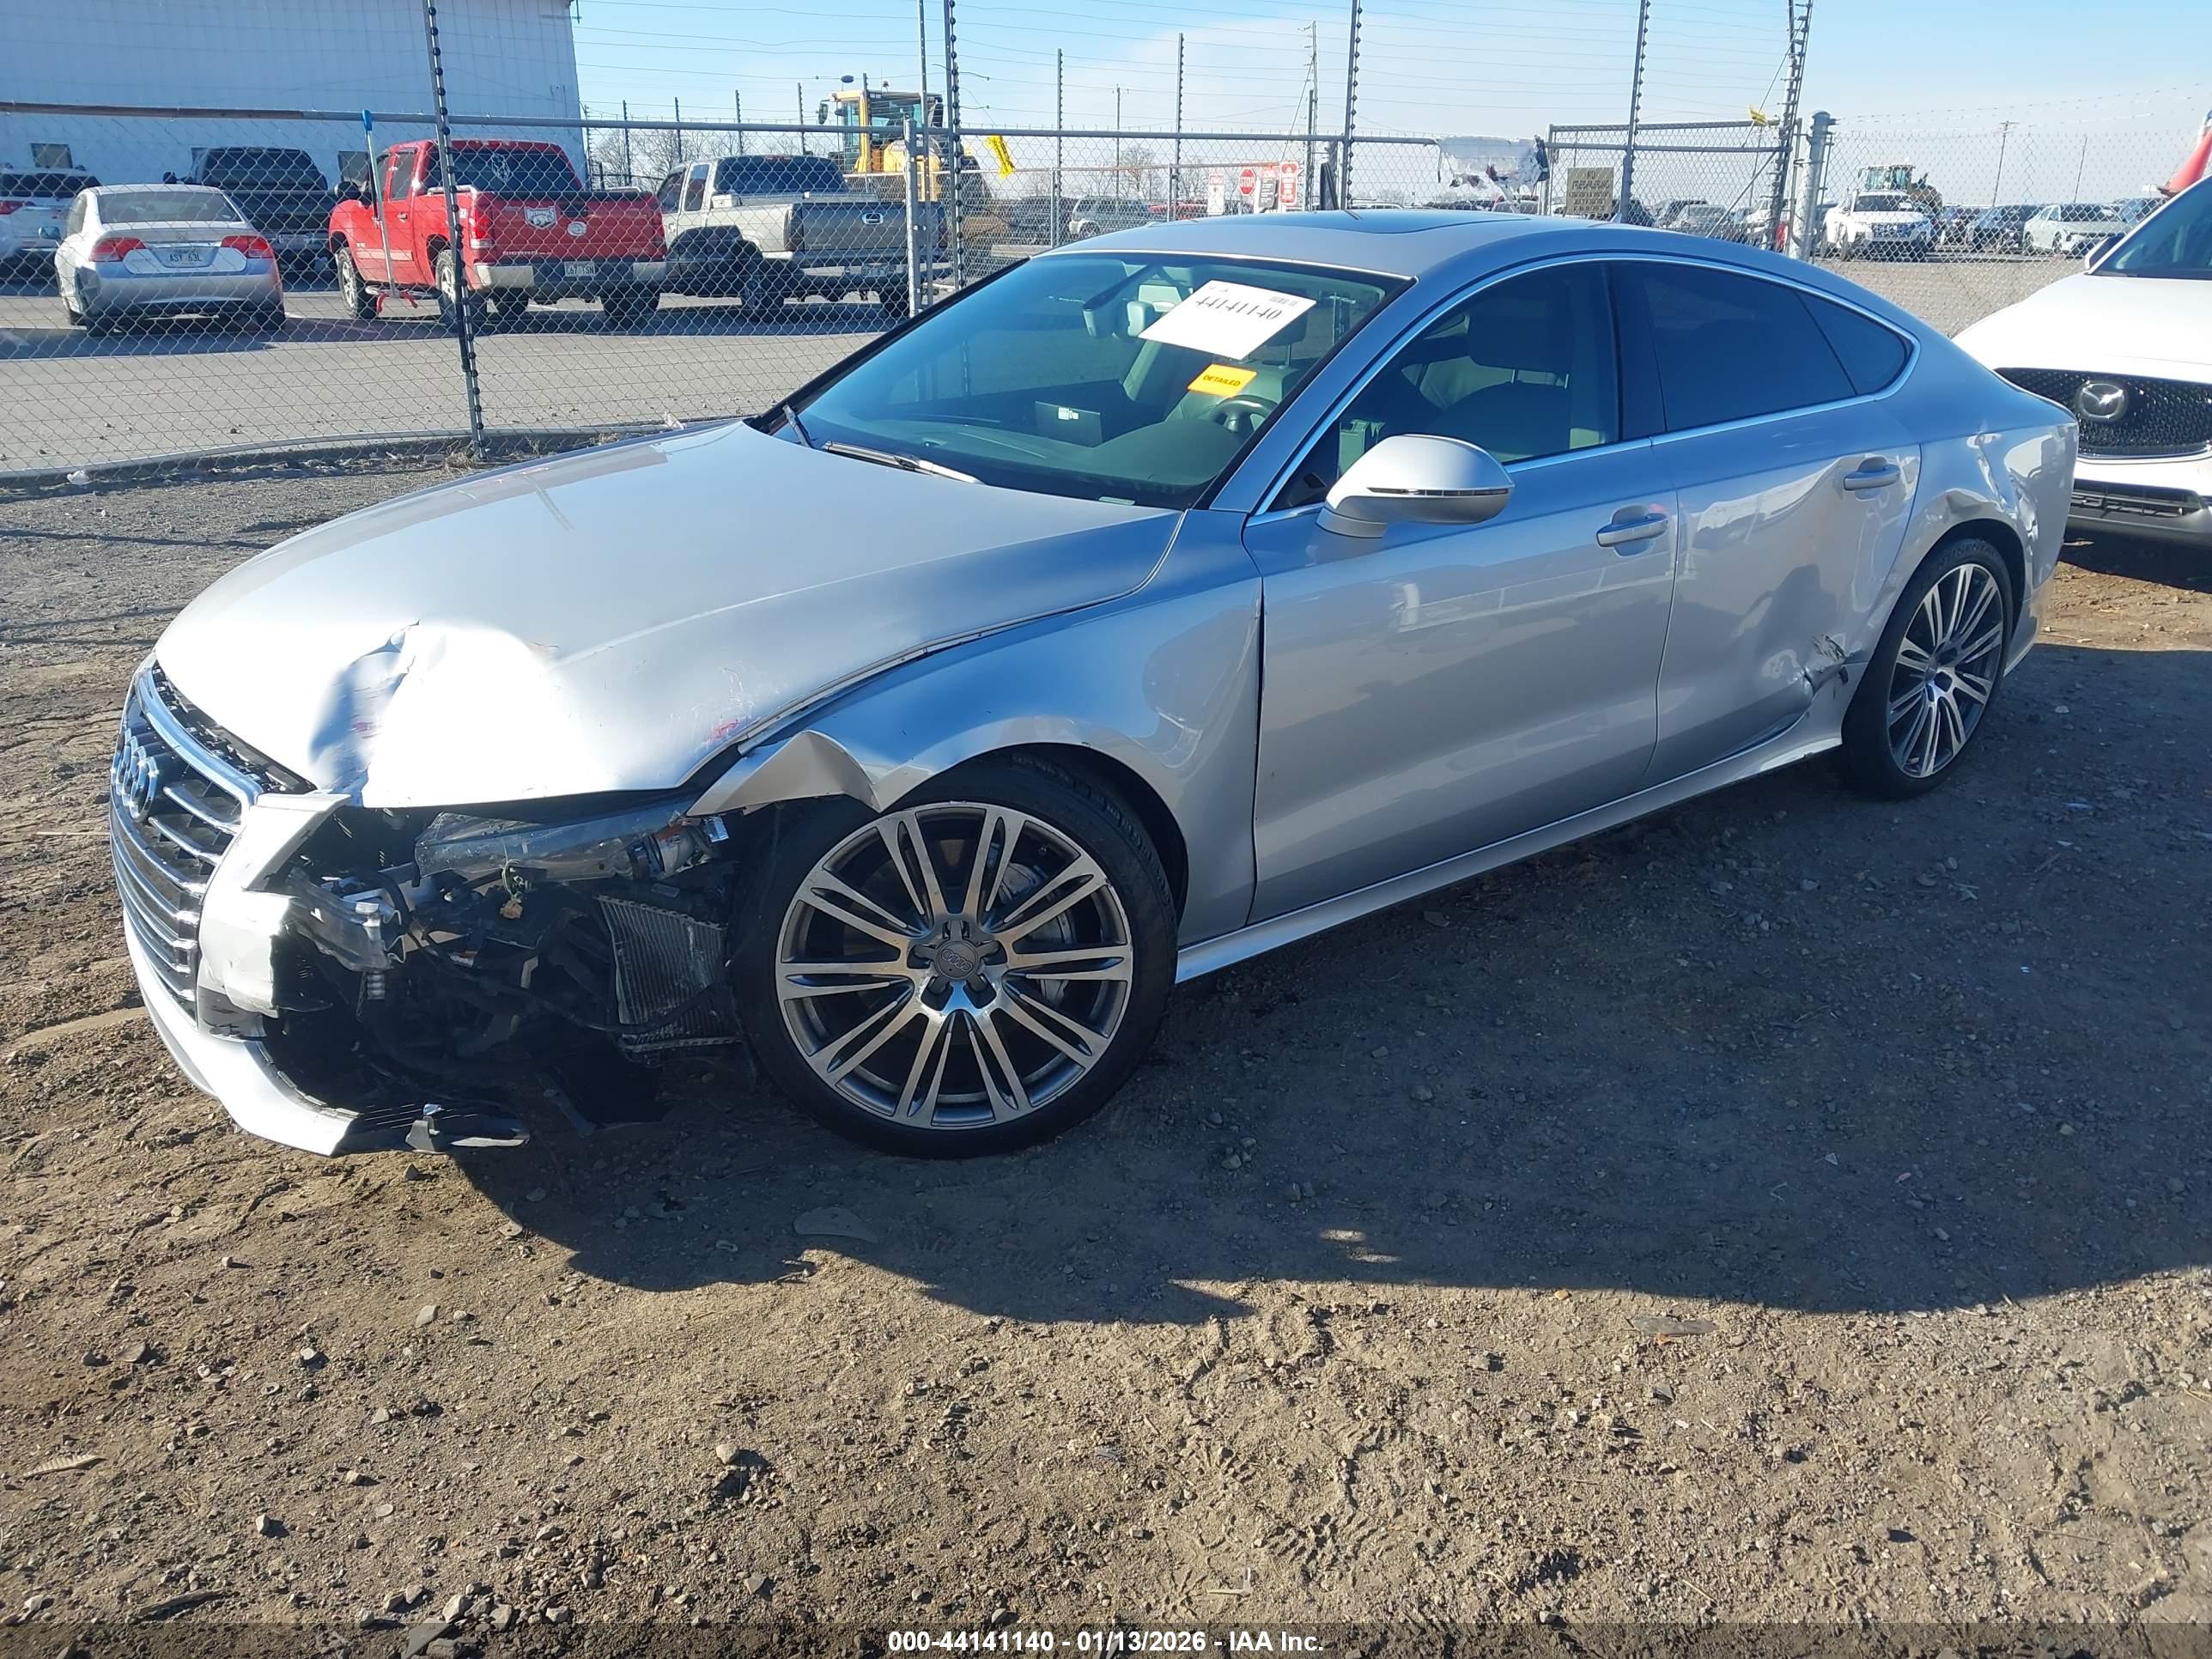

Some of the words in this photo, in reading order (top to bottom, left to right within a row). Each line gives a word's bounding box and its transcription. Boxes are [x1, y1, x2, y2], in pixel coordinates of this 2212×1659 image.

[1239, 176, 1255, 187] STOP
[1195, 295, 1283, 320] 44141140
[1202, 374, 1242, 386] DETAILED
